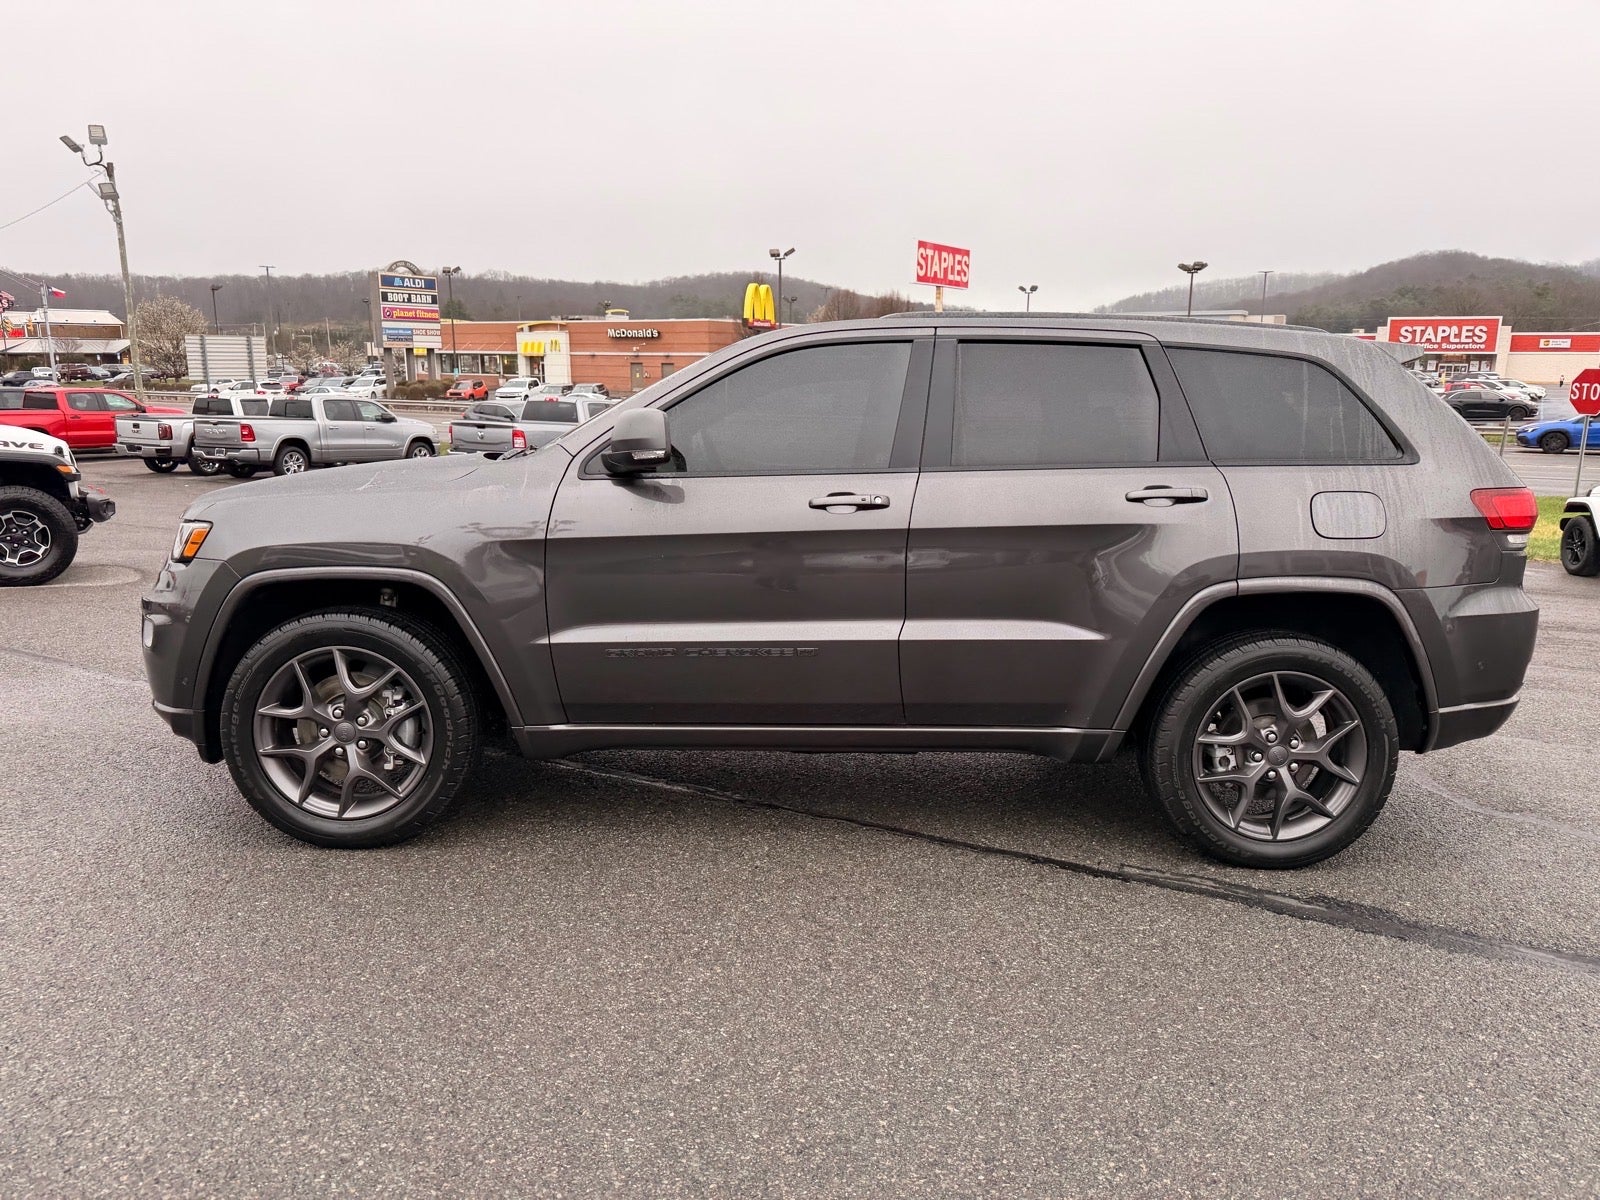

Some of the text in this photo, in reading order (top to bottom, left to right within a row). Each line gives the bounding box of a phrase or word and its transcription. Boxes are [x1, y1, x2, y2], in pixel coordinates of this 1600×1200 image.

[918, 247, 969, 283] STAPLES
[404, 278, 425, 288] ALDI
[387, 292, 432, 303] BOOT BARN
[393, 309, 439, 319] planet fitness
[607, 328, 659, 338] McDonald's
[1399, 325, 1488, 343] STAPLES
